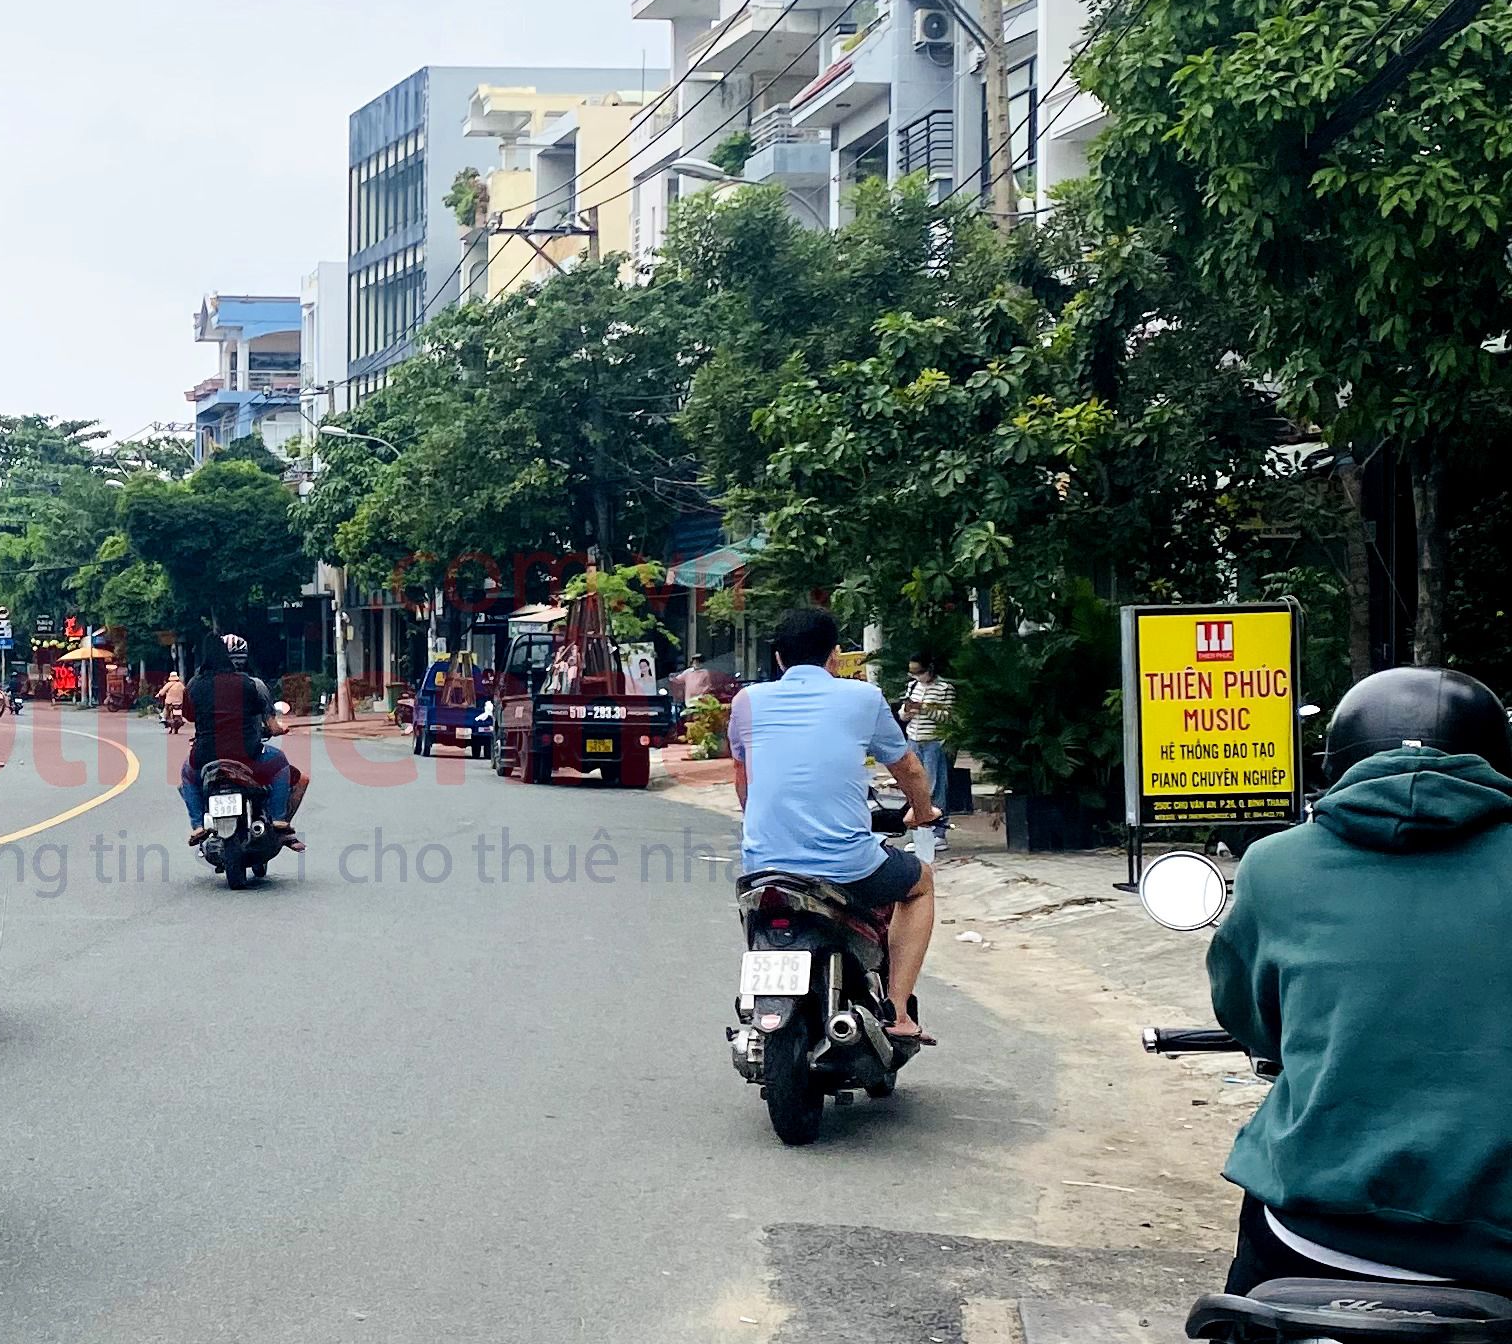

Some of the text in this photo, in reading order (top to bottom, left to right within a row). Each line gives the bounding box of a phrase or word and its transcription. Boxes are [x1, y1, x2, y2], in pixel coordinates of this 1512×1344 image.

[1145, 664, 1288, 701] THIÊN PHÚC
[1184, 707, 1251, 733] MUSIC
[1160, 738, 1276, 763] HỆ THỐNG ĐÀO TẠO
[1151, 767, 1287, 789] PIANO CHUYÊN NGHIỆP
